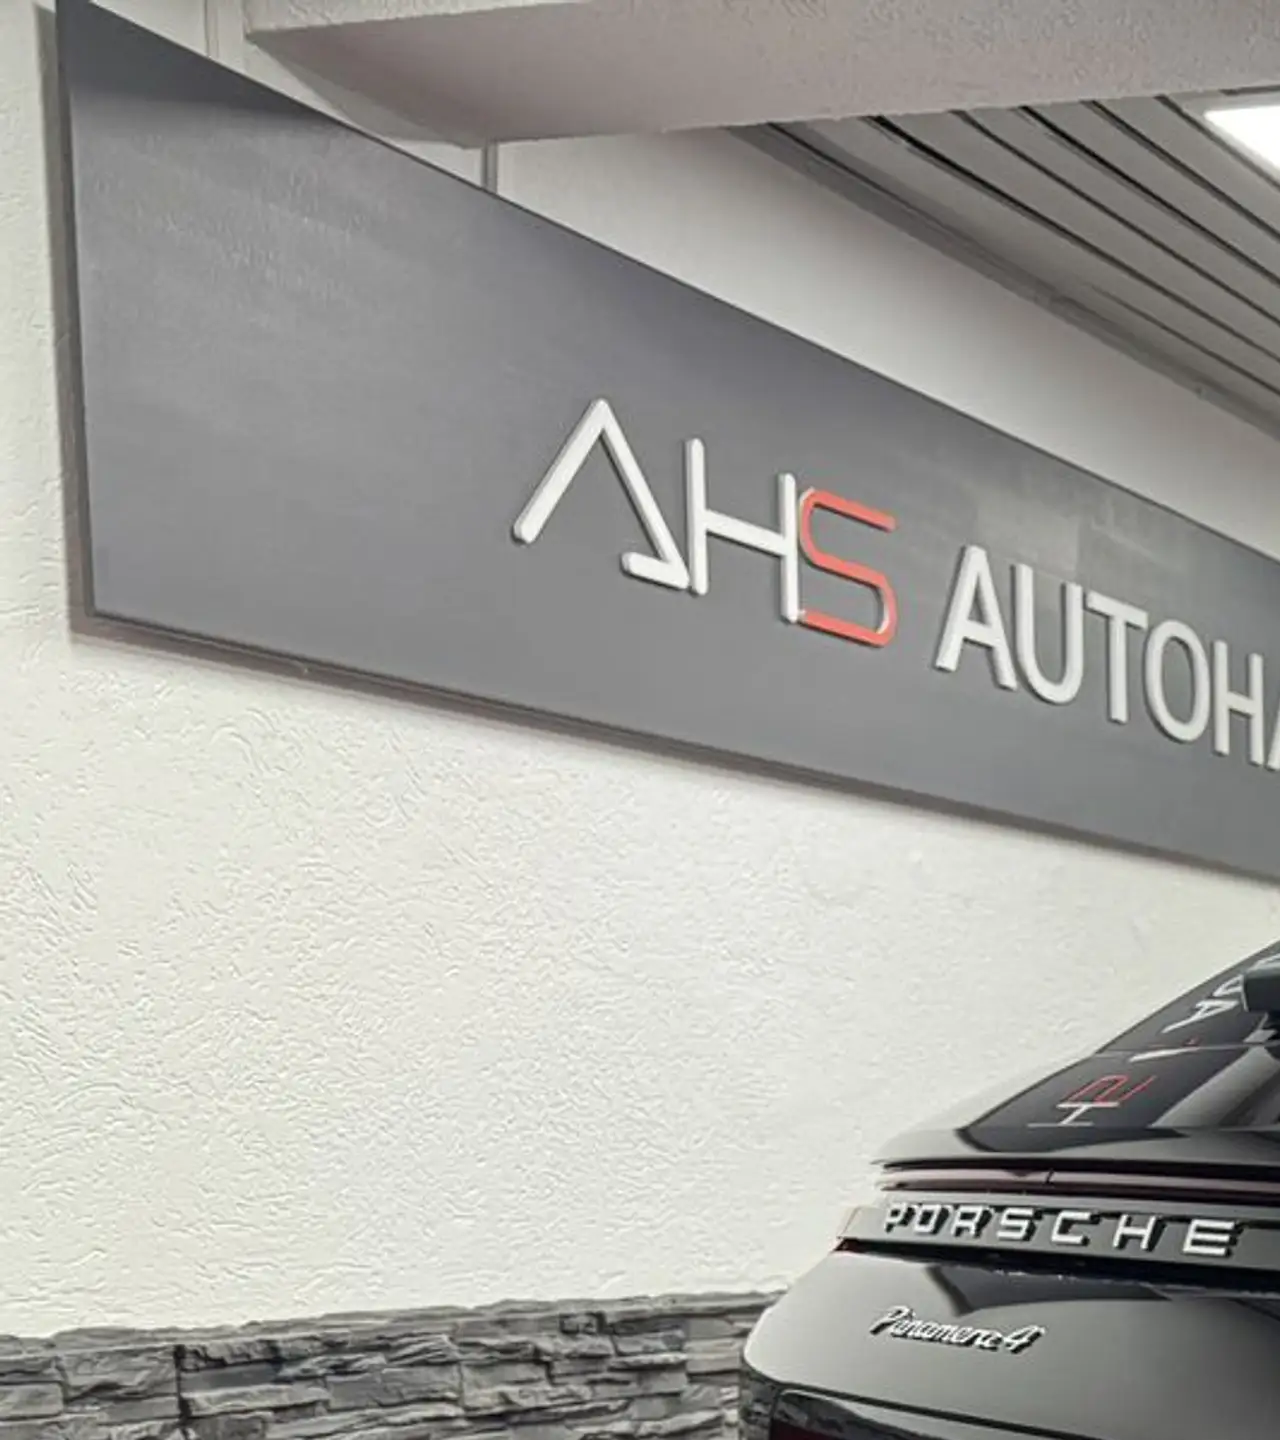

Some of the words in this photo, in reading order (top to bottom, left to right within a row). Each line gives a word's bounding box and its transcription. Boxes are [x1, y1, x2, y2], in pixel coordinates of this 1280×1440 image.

[513, 398, 896, 647] AHS
[884, 1203, 1235, 1256] PORSCHE
[870, 1305, 1002, 1350] Panamera
